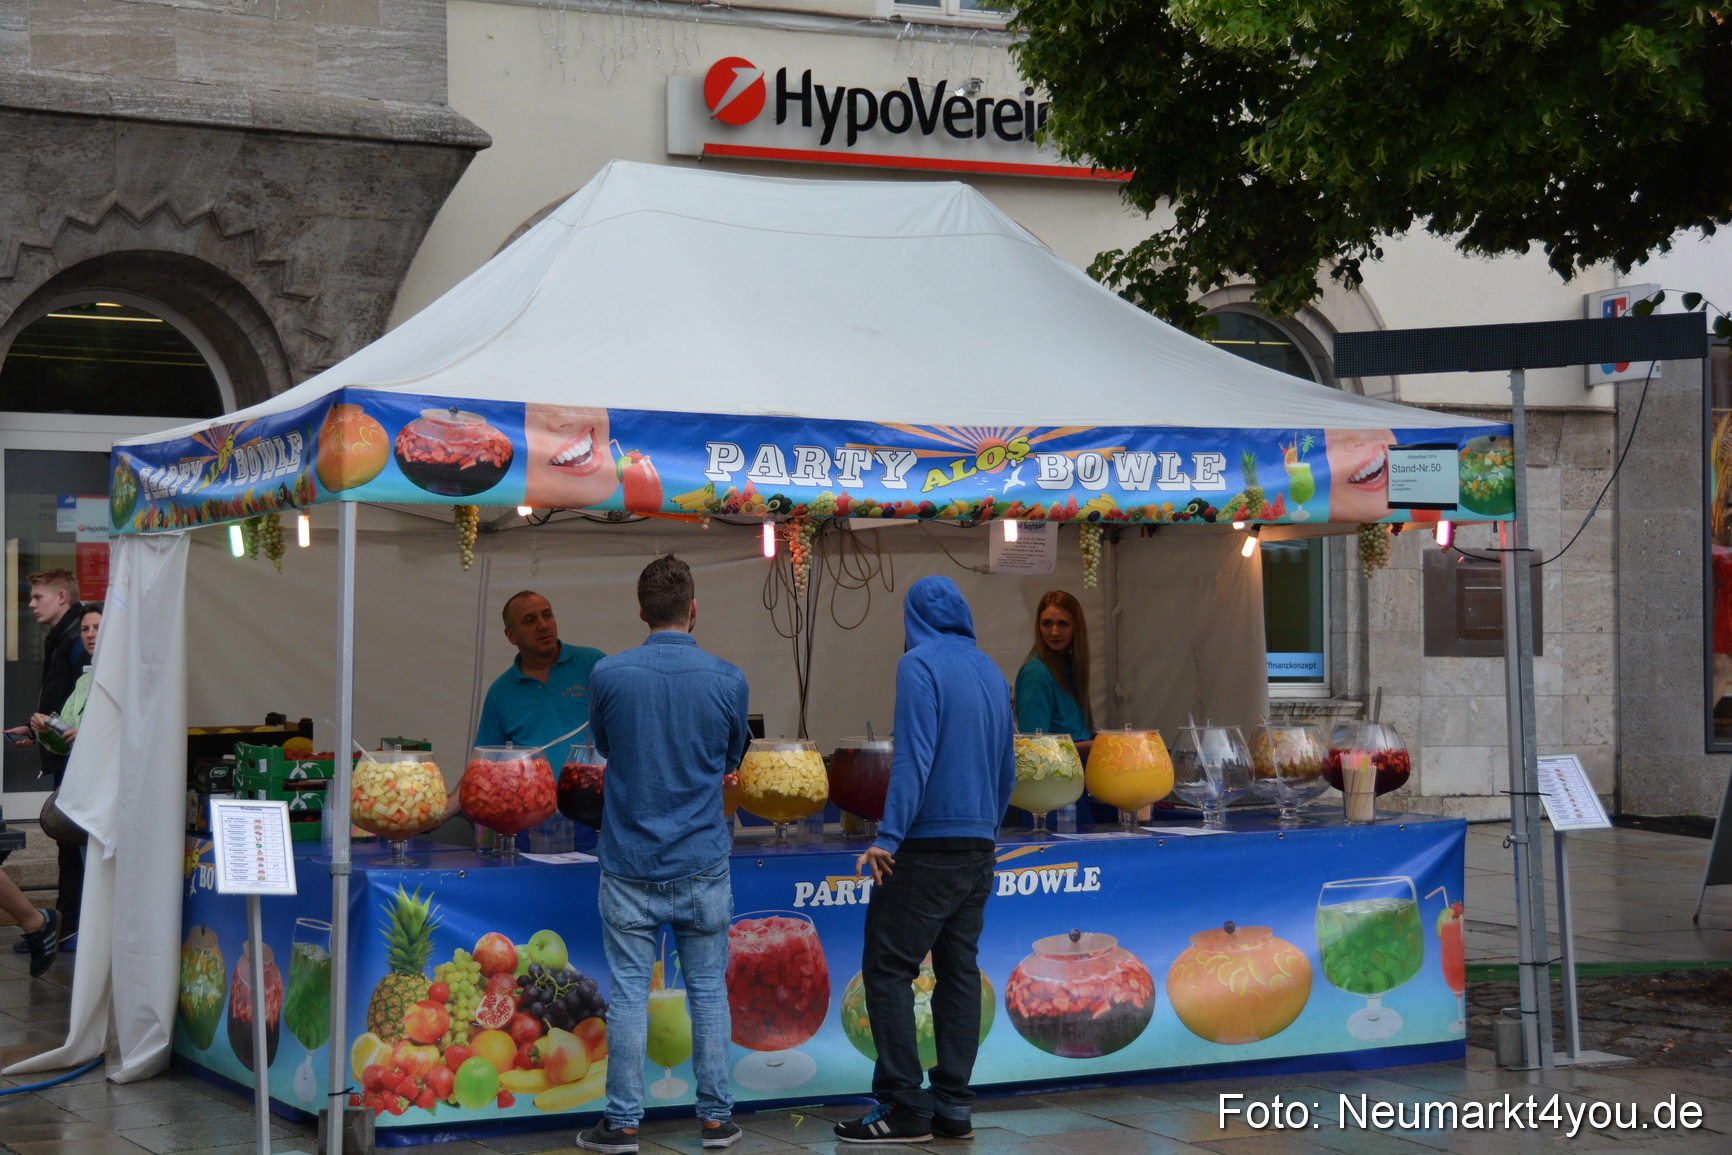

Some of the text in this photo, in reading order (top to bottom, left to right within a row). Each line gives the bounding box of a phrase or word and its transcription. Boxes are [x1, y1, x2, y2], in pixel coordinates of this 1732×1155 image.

[233, 430, 303, 487] BOWLE
[704, 441, 918, 488] PARTY
[1034, 451, 1227, 491] BOWLE
[1391, 463, 1442, 473] Stand-Nr.50
[85, 525, 109, 533] HypoVe
[793, 866, 1101, 908] PART BOWLE
